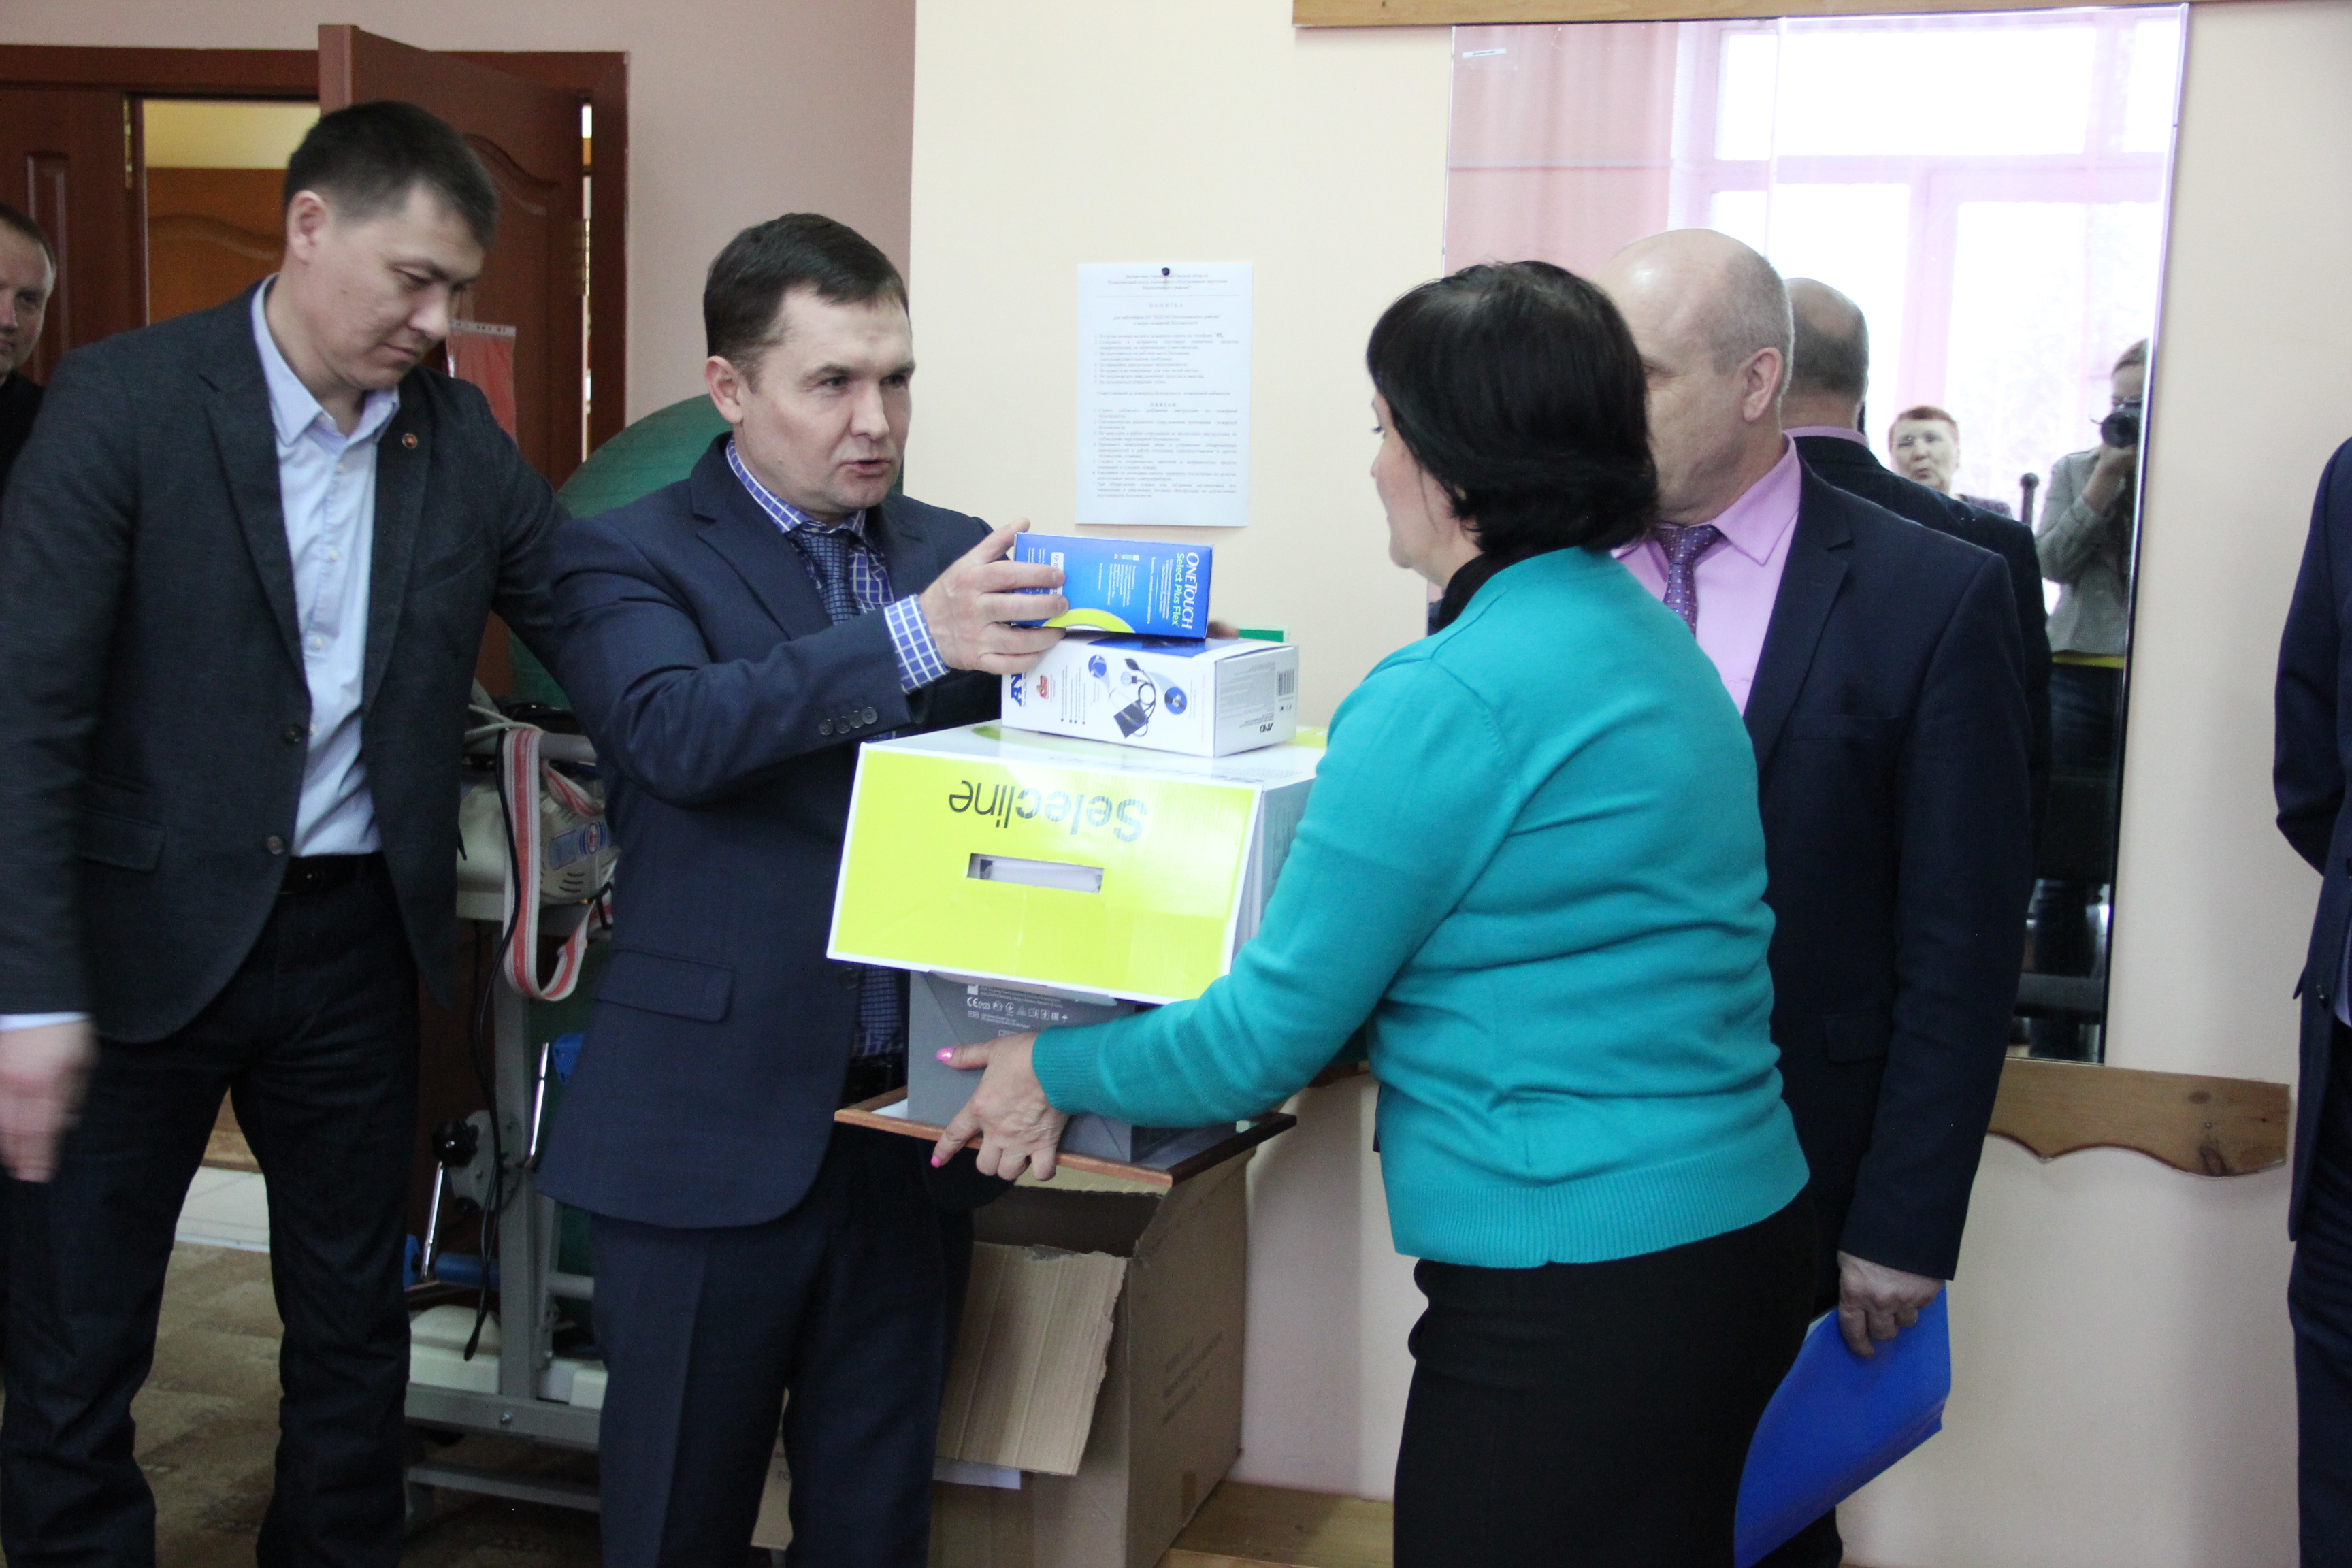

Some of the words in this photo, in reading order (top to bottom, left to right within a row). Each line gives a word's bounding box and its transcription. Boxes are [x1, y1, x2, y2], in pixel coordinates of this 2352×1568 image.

[1175, 553, 1184, 582] Select
[1173, 584, 1182, 604] Plus
[1172, 606, 1181, 626] Flex
[949, 781, 1147, 843] Selecline
